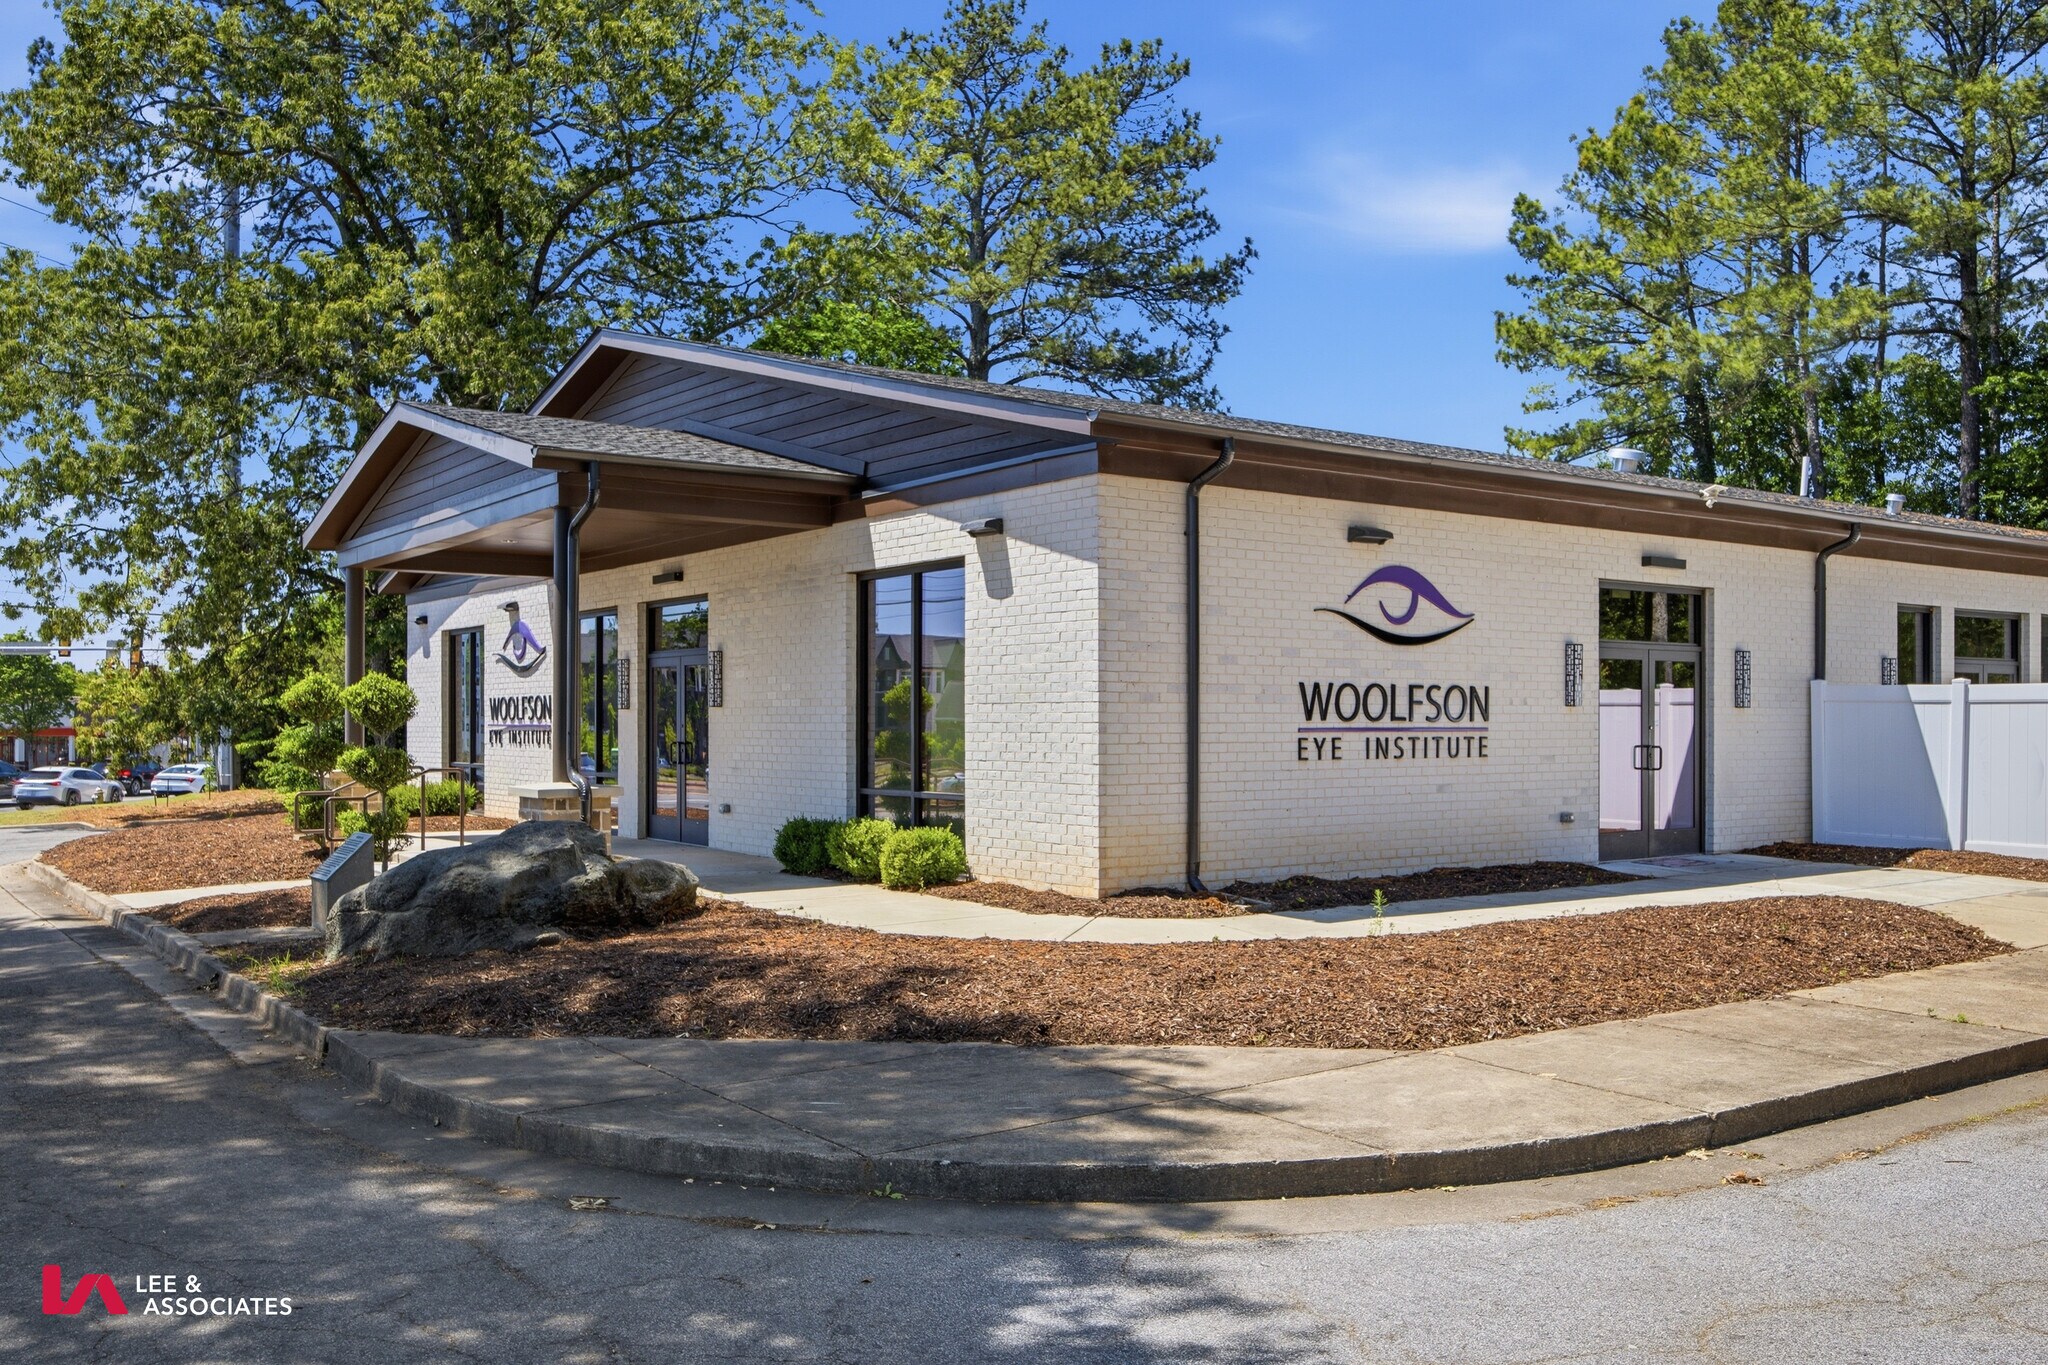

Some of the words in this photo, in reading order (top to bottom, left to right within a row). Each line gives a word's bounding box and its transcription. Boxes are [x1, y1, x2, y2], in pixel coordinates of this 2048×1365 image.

[489, 695, 552, 722] WOOLFSON
[1299, 682, 1489, 723] WOOLFSON
[489, 729, 503, 746] EYE
[509, 729, 552, 746] INSTITUTE
[1298, 737, 1342, 761] EYE
[1365, 736, 1489, 760] INSTITUTE
